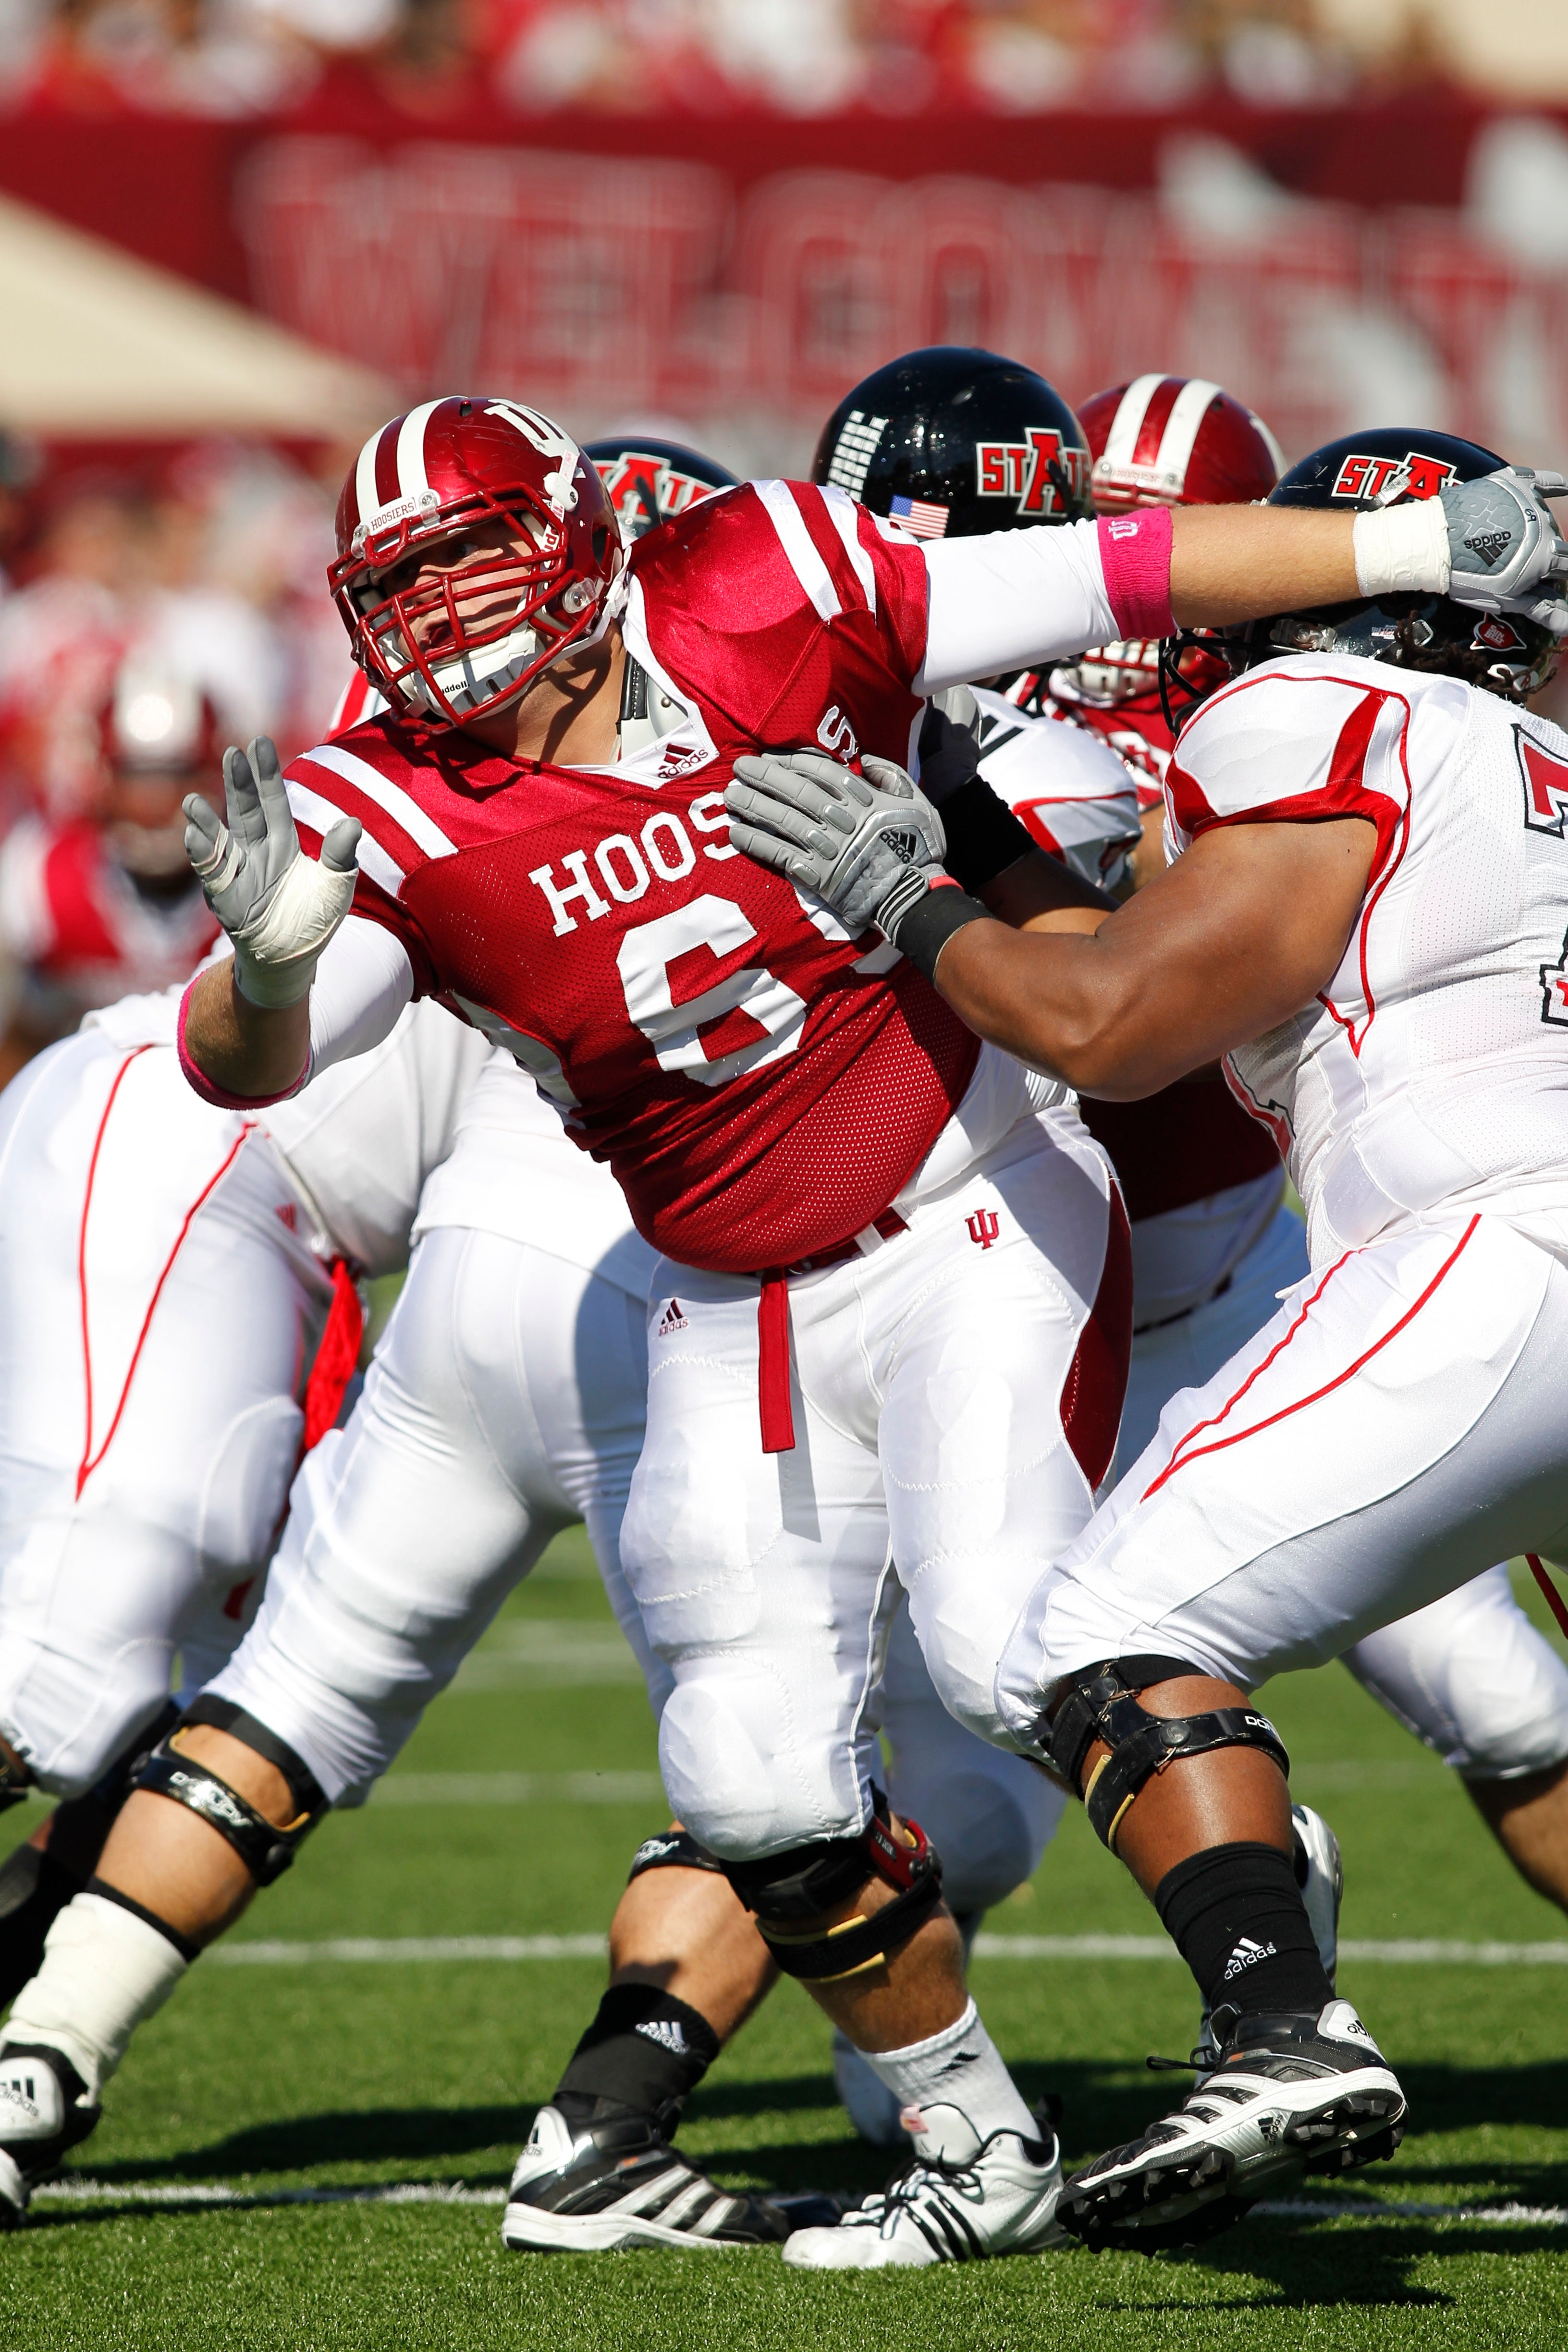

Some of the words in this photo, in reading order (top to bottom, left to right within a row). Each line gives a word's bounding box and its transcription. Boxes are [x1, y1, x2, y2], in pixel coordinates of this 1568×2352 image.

[370, 502, 415, 531] HOOSIERS
[1464, 531, 1511, 549] adidas
[1483, 630, 1505, 645] BELT
[1489, 625, 1505, 638] SUN
[658, 749, 709, 779] adidas
[1224, 1945, 1277, 1980] adidas
